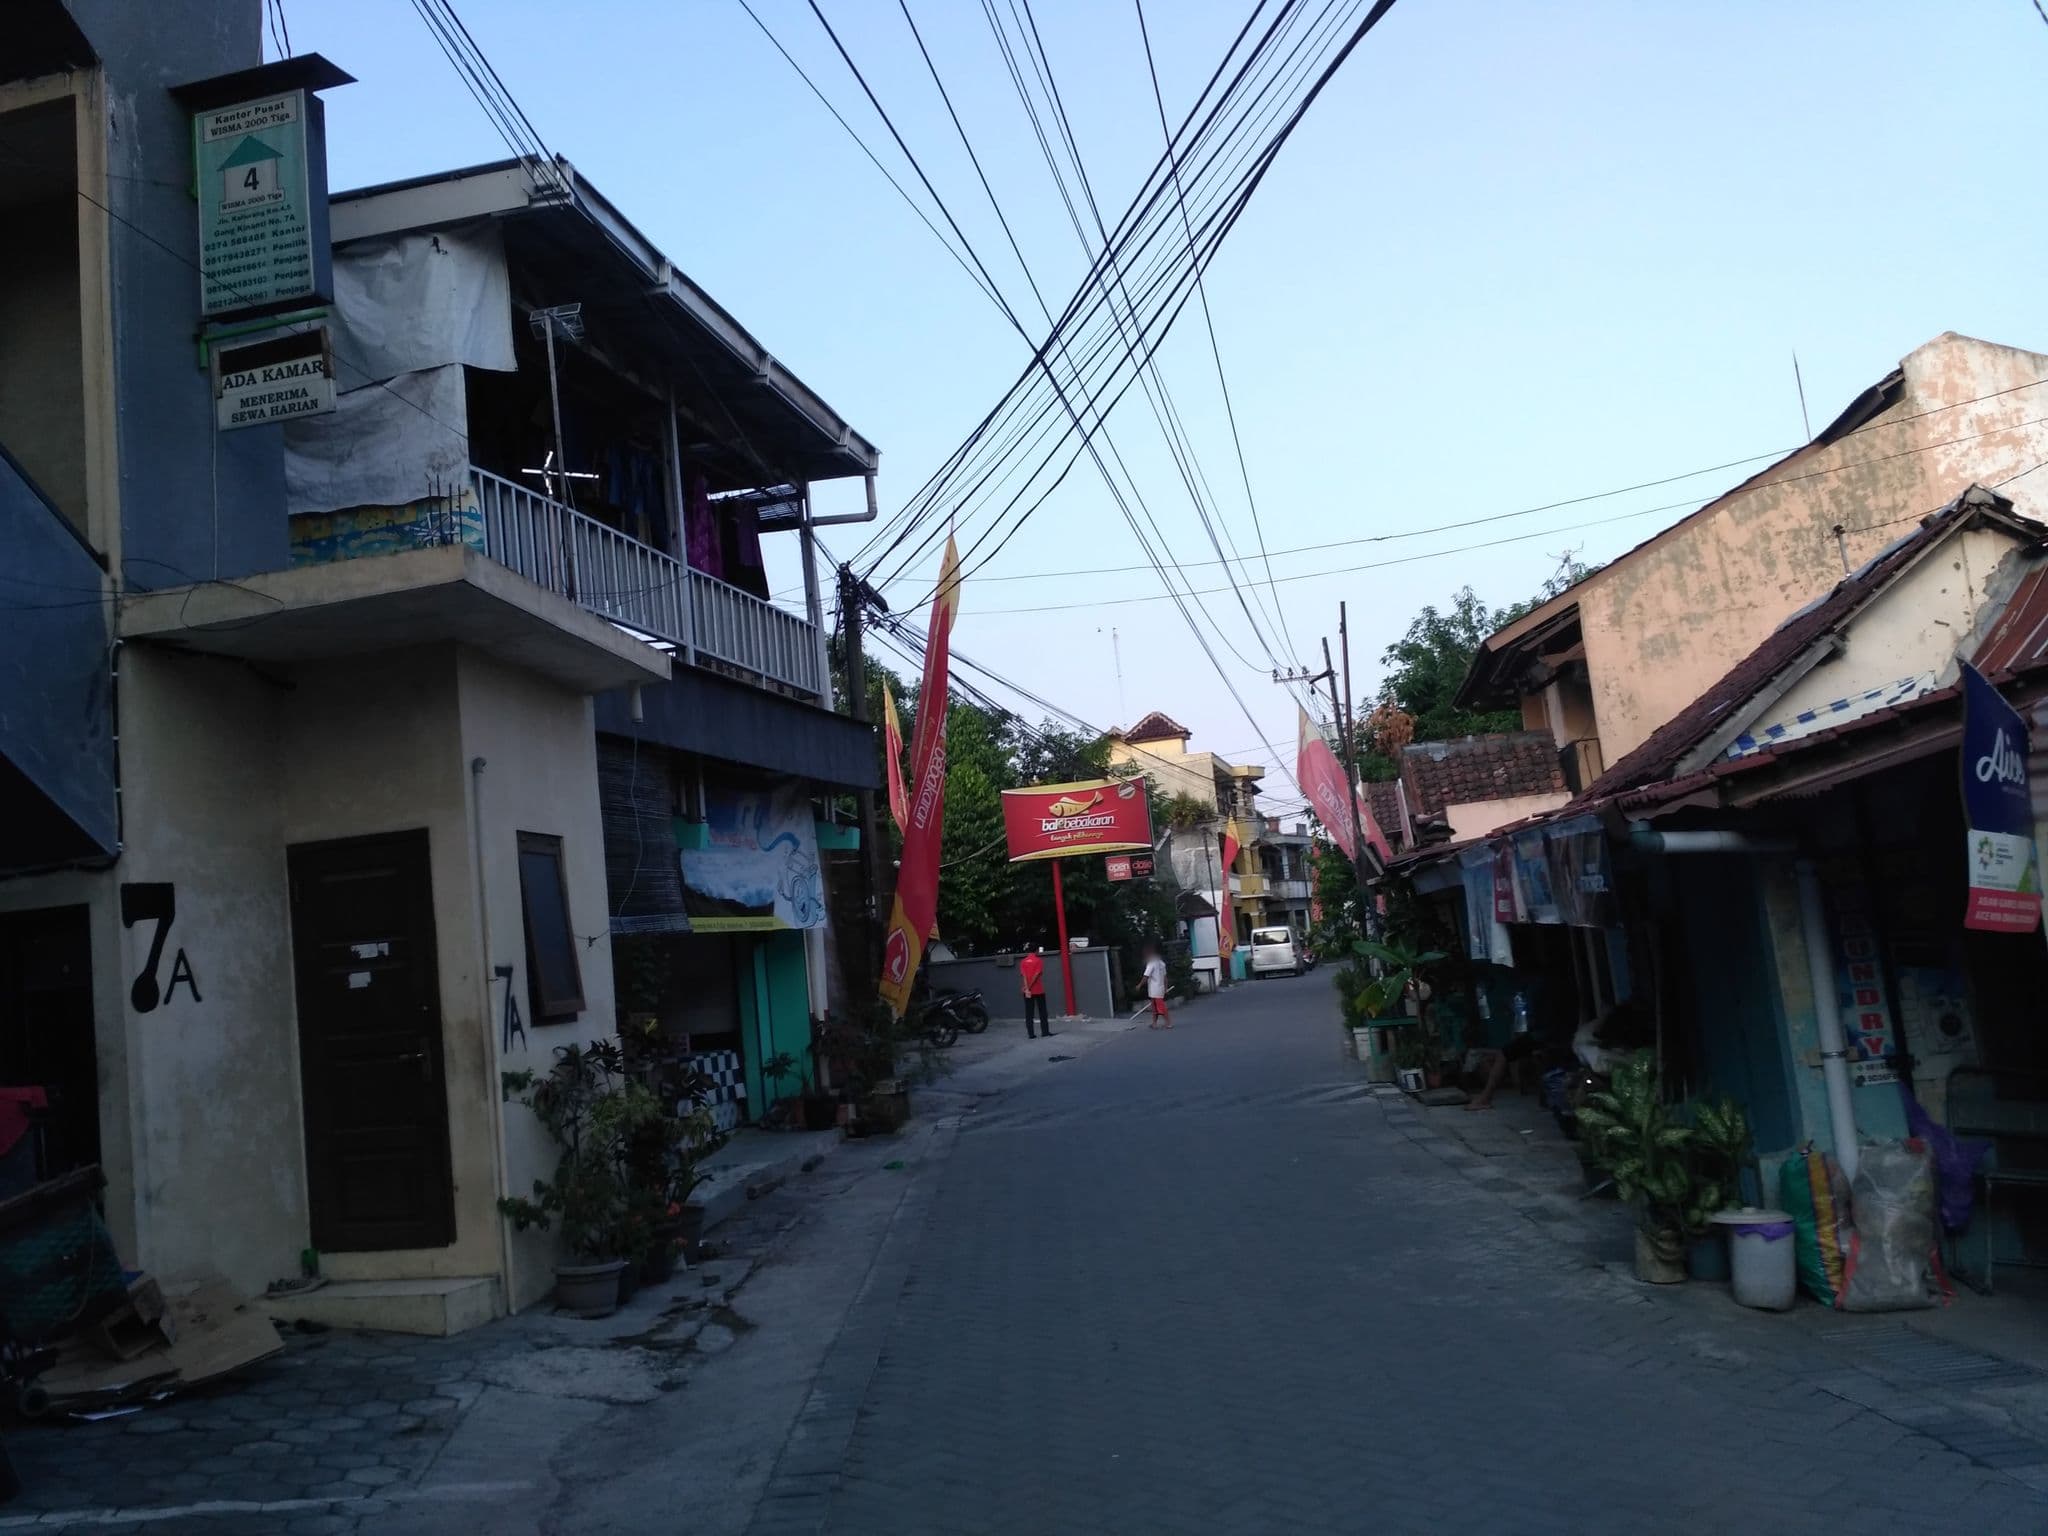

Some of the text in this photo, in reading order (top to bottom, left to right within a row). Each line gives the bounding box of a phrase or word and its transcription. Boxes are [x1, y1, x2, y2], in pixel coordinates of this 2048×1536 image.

[210, 112, 290, 136] WISMA 2000 Tiga
[215, 101, 285, 125] Kantor Pusat
[243, 167, 260, 191] 4
[222, 198, 246, 210] WISMA
[247, 195, 266, 205] 2000
[284, 213, 296, 223] 7A
[271, 225, 305, 238] Kantor
[223, 360, 323, 390] ADA KAMAR
[240, 387, 309, 409] MENERIMA
[231, 398, 319, 423] SEWA HARIAN
[120, 882, 202, 1014] 7A
[494, 965, 527, 1054] 7A
